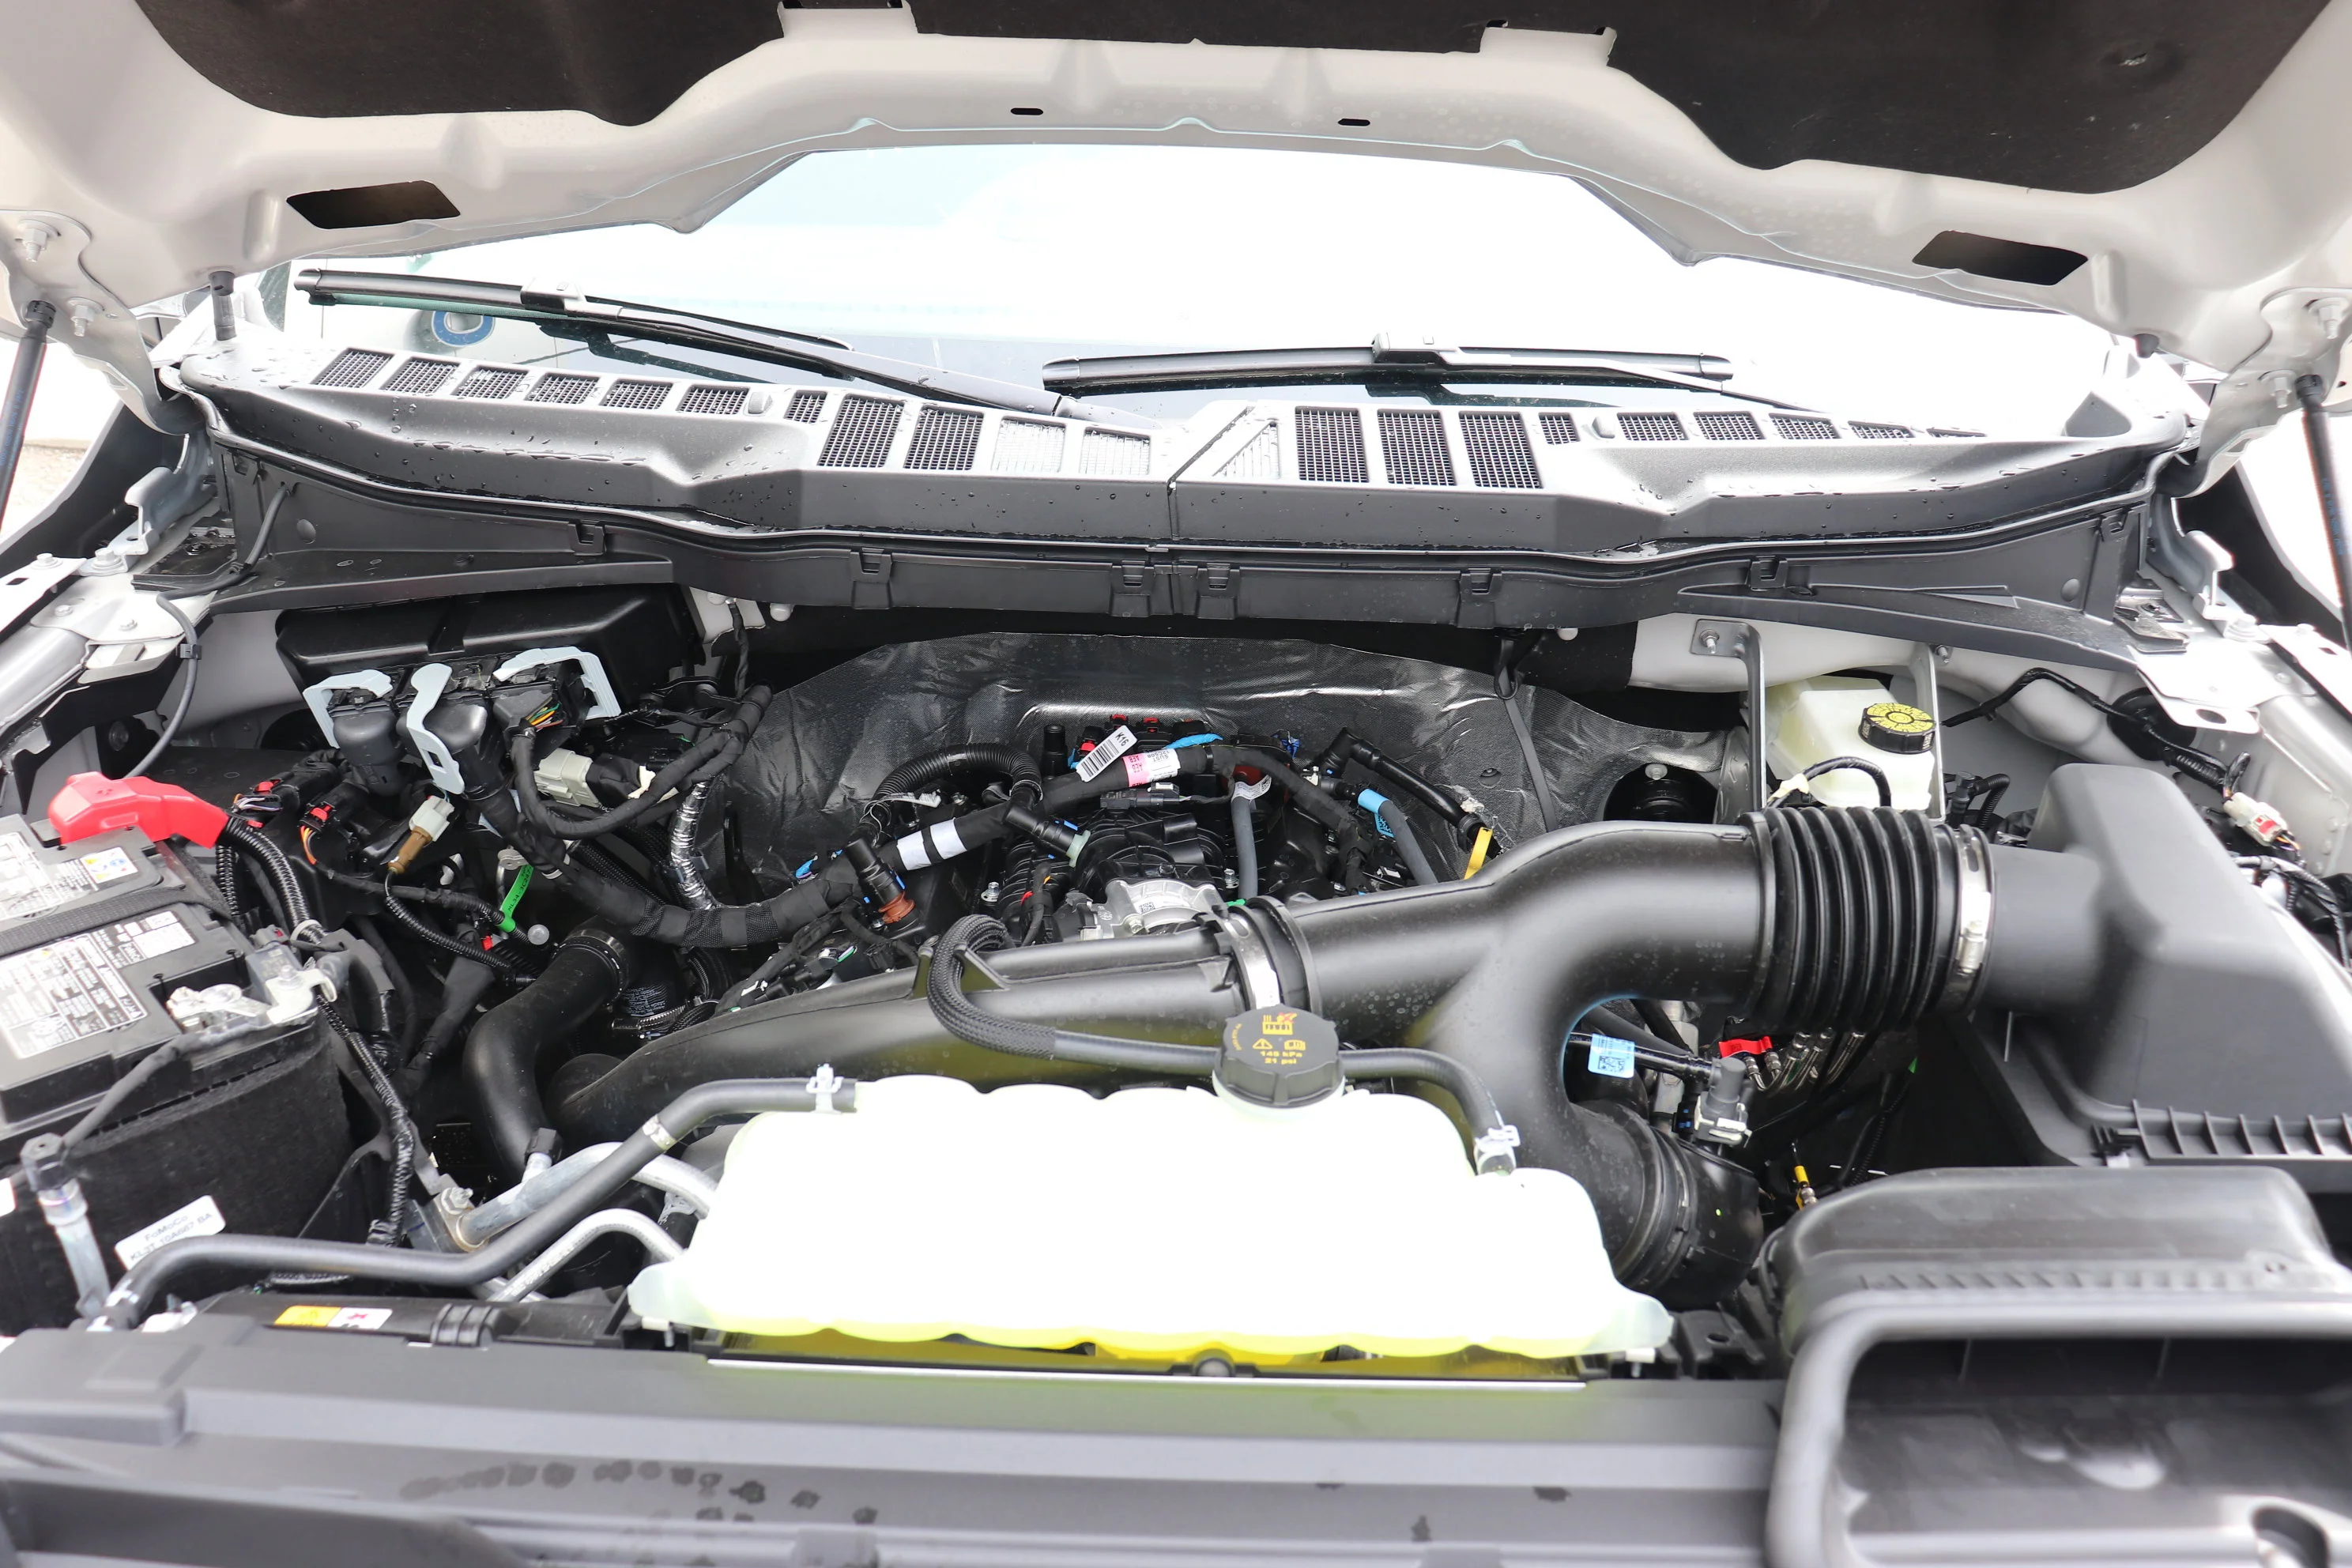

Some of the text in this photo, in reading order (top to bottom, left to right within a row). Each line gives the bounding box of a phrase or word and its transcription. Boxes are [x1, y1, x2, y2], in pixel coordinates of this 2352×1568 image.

[1115, 732, 1129, 747] K16
[197, 1212, 213, 1224] BA
[145, 1215, 188, 1242] FoMoCo
